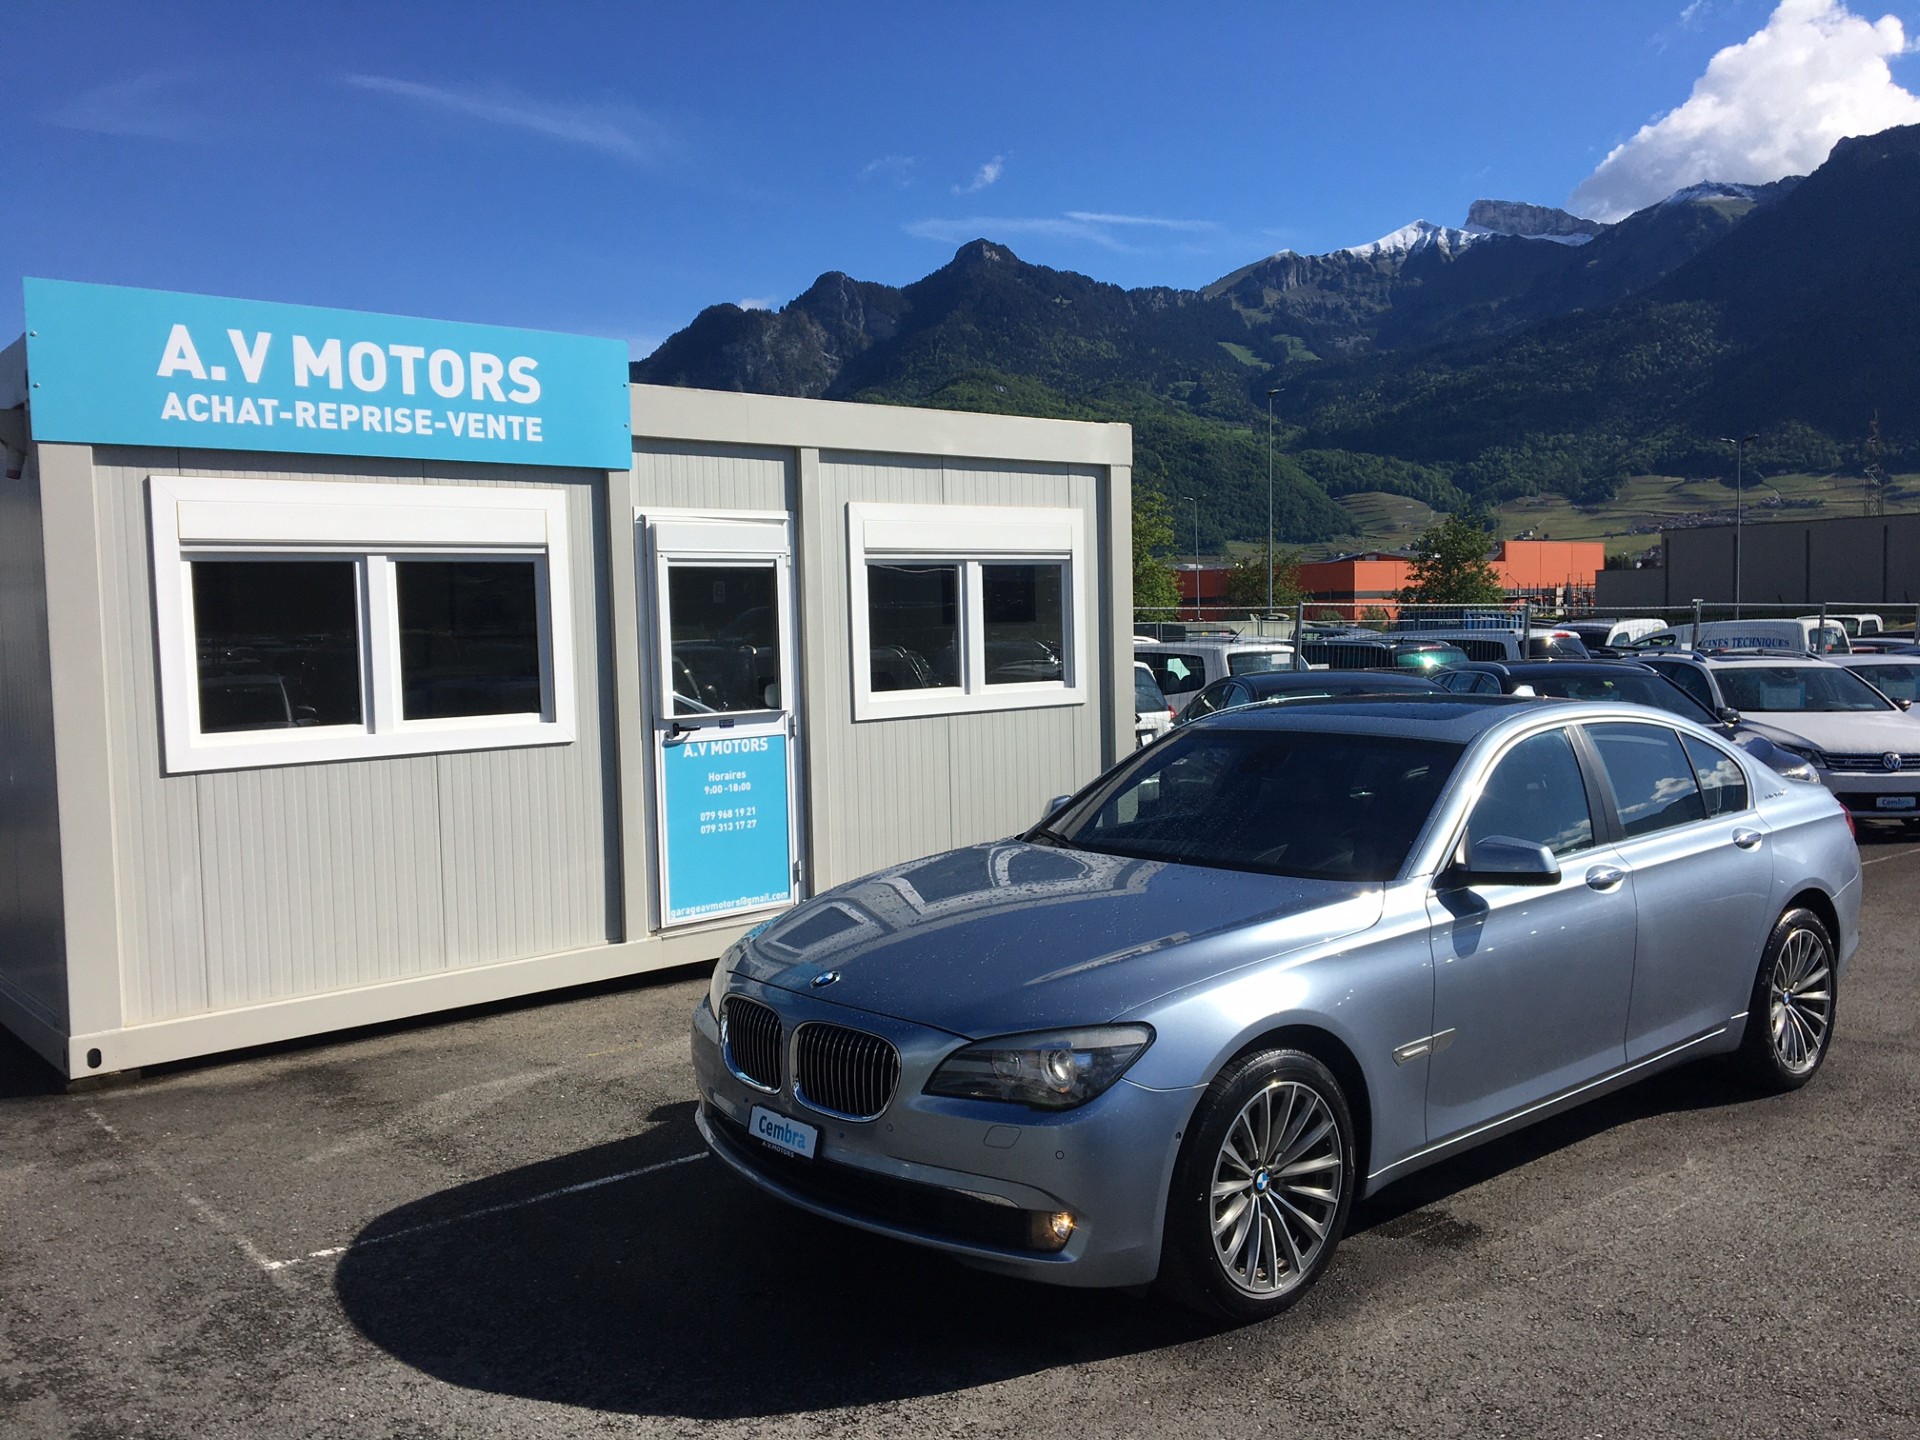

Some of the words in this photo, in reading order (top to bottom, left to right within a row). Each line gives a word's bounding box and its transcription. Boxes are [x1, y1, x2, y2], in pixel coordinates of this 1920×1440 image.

[156, 322, 273, 384] A.V
[291, 334, 542, 405] MOTORS
[160, 391, 543, 442] ACHAT-REPRISE-VENTE
[1732, 637, 1790, 648] TECHNIQUES
[683, 741, 708, 758] A.V
[711, 738, 768, 756] MOTORS
[708, 770, 747, 782] Horaires
[700, 811, 716, 822] 079
[717, 809, 733, 820] 968
[735, 808, 745, 818] 19
[746, 806, 756, 817] 21
[700, 824, 716, 835] 079
[718, 822, 733, 833] 313
[735, 821, 745, 831] 17
[746, 819, 757, 829] 27
[670, 891, 788, 918] garageavmotors@gmail.com
[759, 1115, 806, 1149] Cembra
